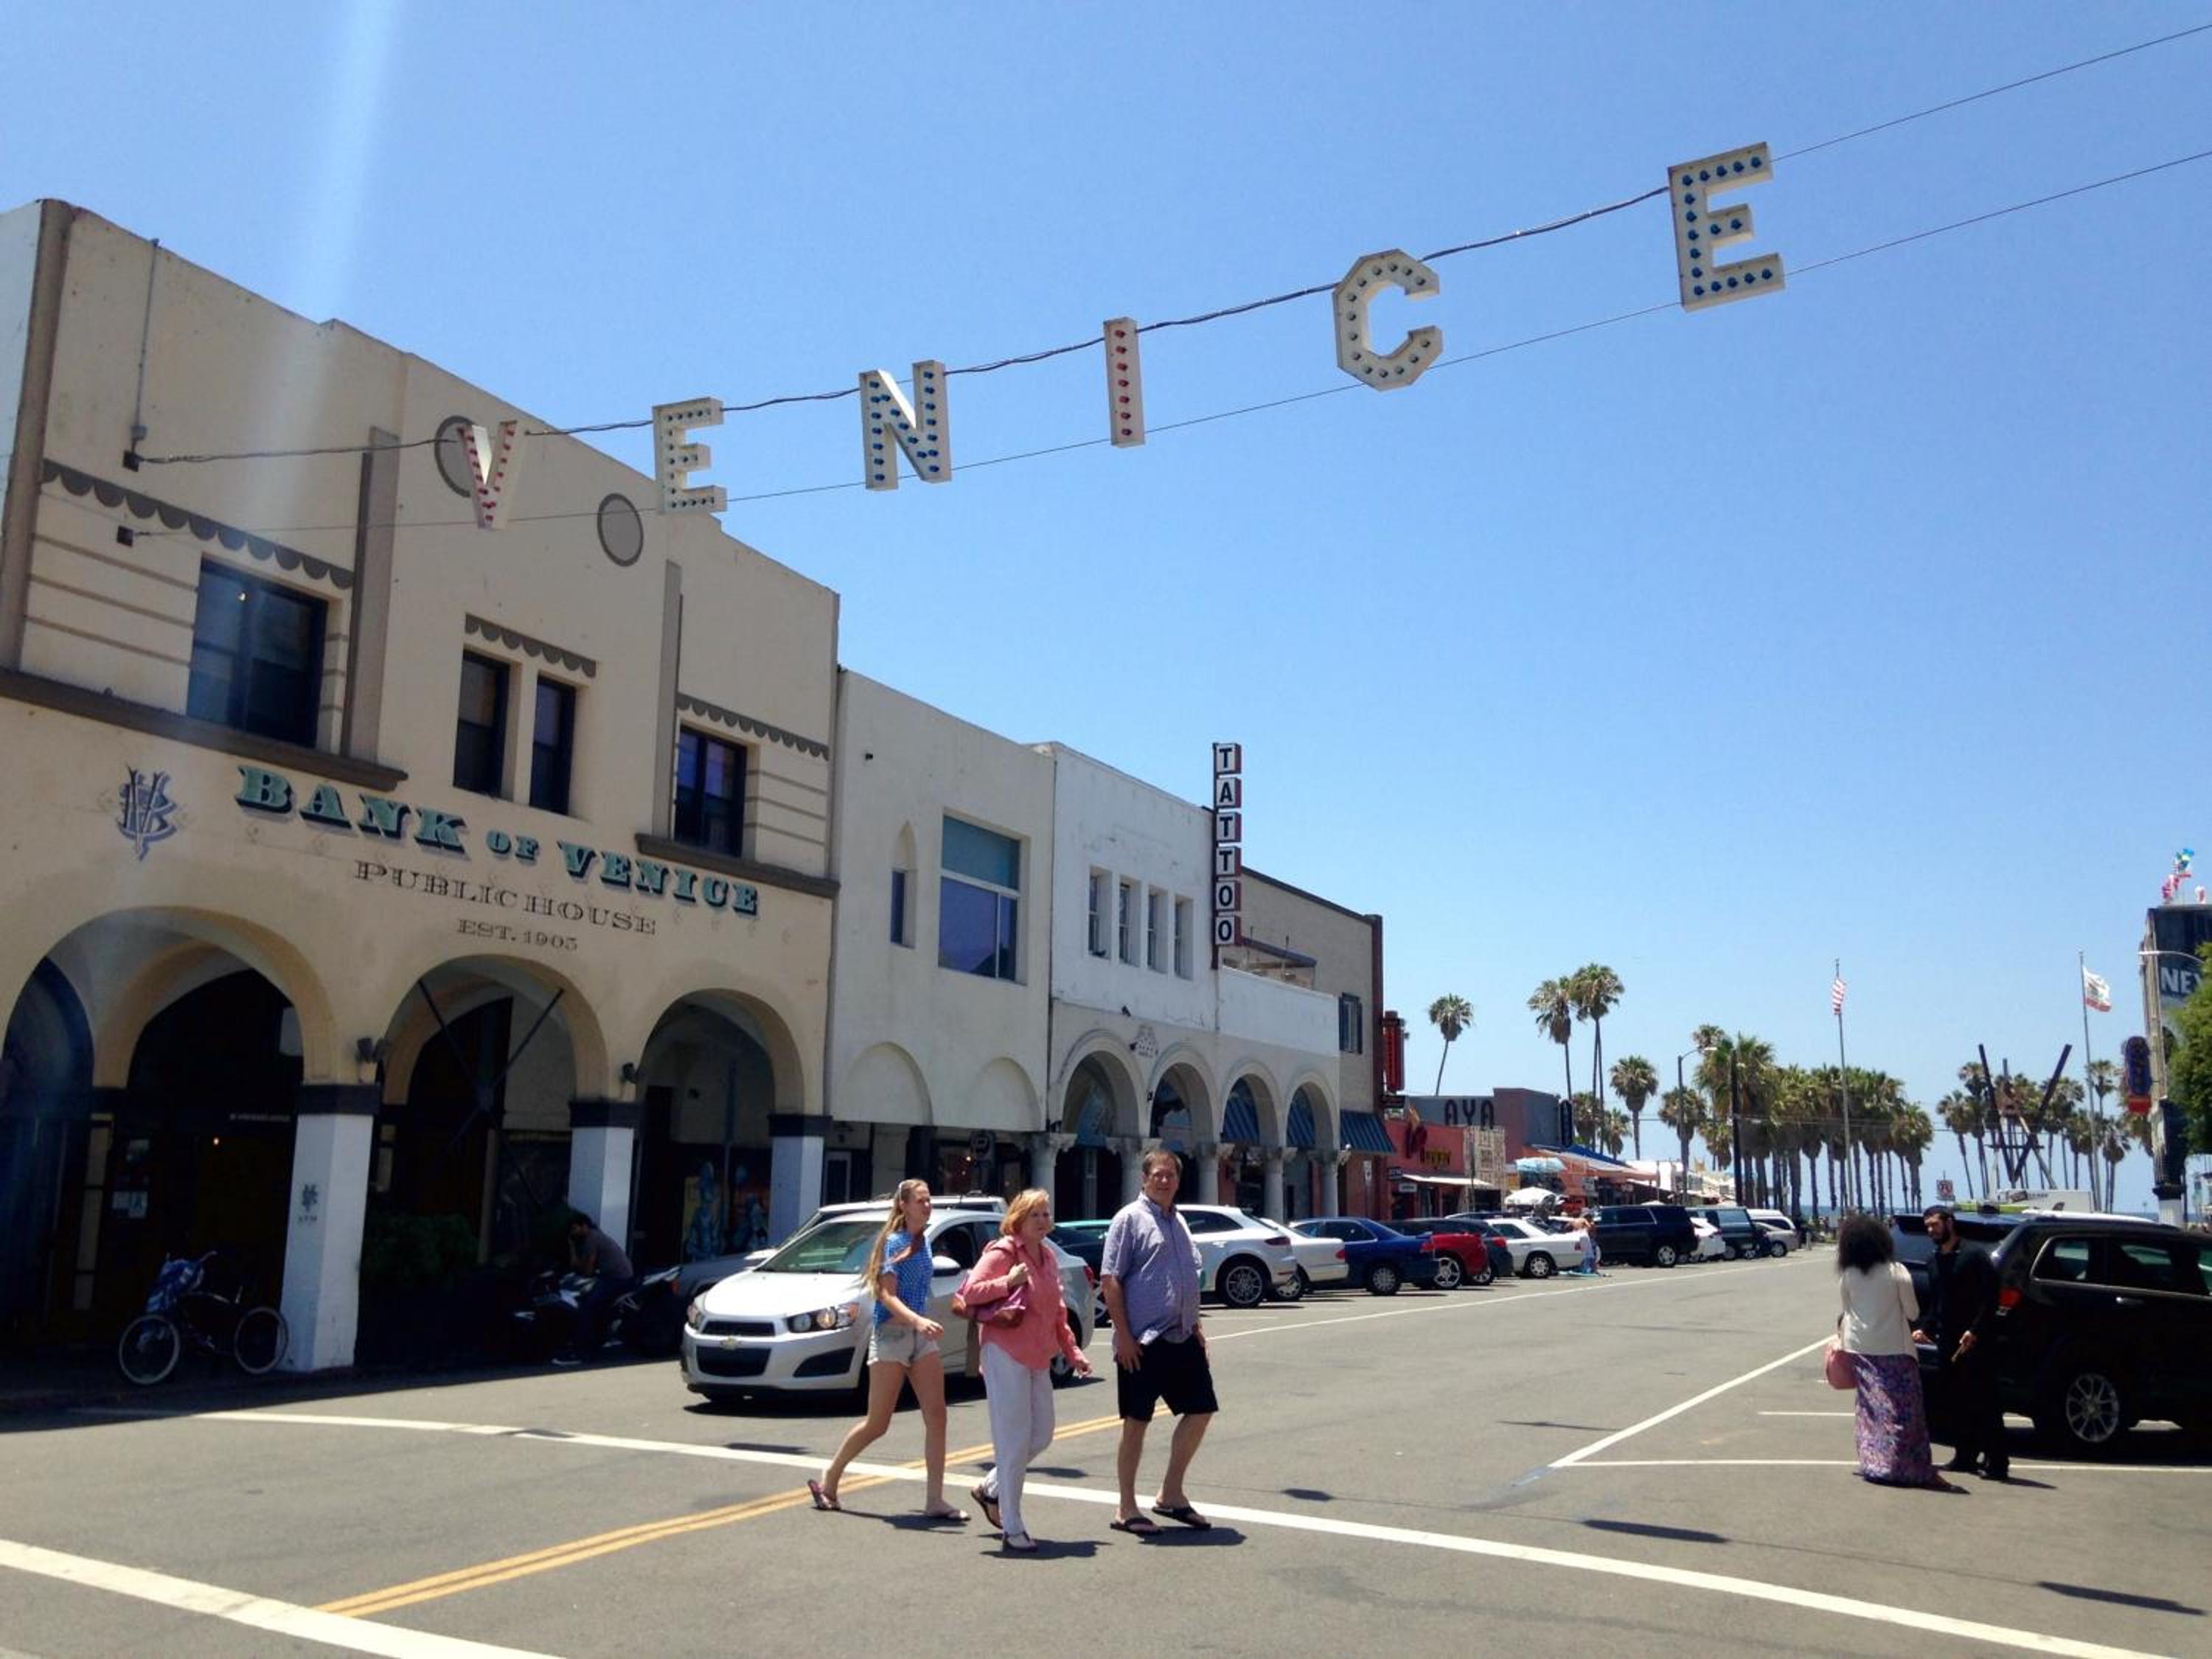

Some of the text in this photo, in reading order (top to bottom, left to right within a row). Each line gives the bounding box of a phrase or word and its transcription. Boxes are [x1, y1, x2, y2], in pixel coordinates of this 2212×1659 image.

[458, 141, 1786, 531] VENICE
[236, 765, 467, 854] BANK
[485, 829, 539, 862] OF
[557, 839, 759, 916] VENICE
[354, 859, 657, 936] PUBLIC HOUSE
[1218, 746, 1234, 942] TATTOO
[457, 918, 579, 952] EST. 1905
[1444, 1098, 1495, 1132] AYA
